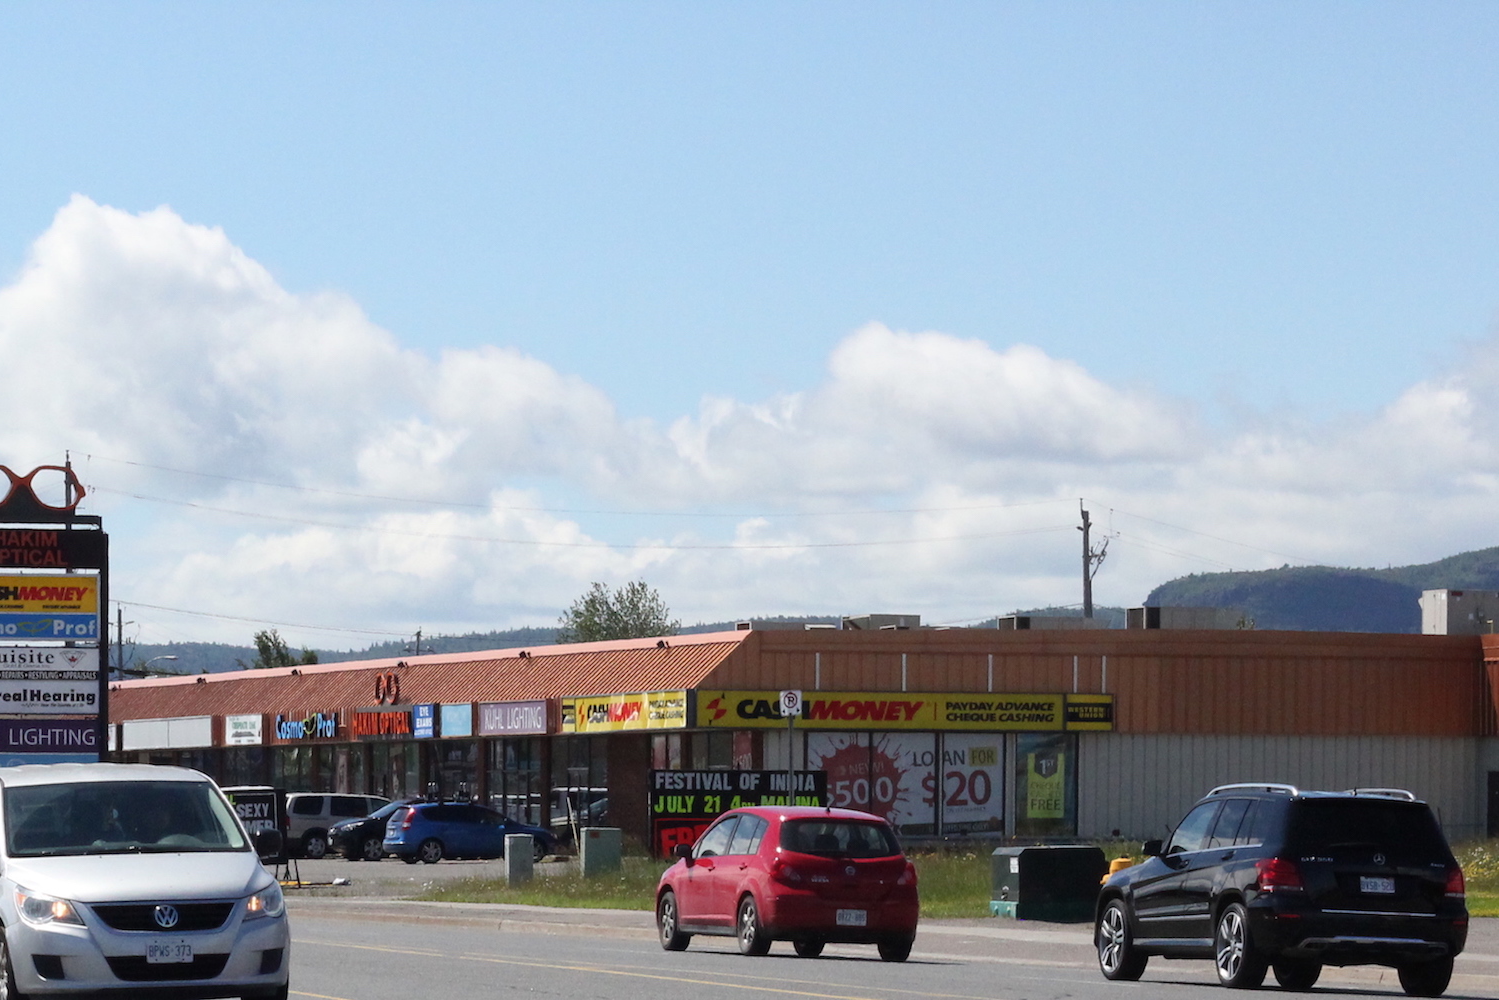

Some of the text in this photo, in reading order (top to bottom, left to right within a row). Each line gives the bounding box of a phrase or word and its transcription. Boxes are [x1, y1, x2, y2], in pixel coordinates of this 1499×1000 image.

[53, 619, 96, 636] Prof
[419, 706, 429, 717] EYE
[946, 702, 1055, 712] PAYDAY ADVANCE
[276, 714, 304, 739] Cosmo
[317, 713, 336, 738] Prof
[506, 706, 542, 730] LIGHTING
[946, 713, 1055, 723] CHEQUE CASHING
[8, 728, 96, 746] LIGHTING
[912, 749, 995, 767] LOAN FOR
[655, 772, 816, 791] FESTIVAL OF INDIA
[922, 770, 992, 808] $20
[236, 803, 269, 818] SEXY
[654, 795, 695, 813] JULY
[703, 795, 721, 813] 21
[1030, 798, 1061, 811] FREE
